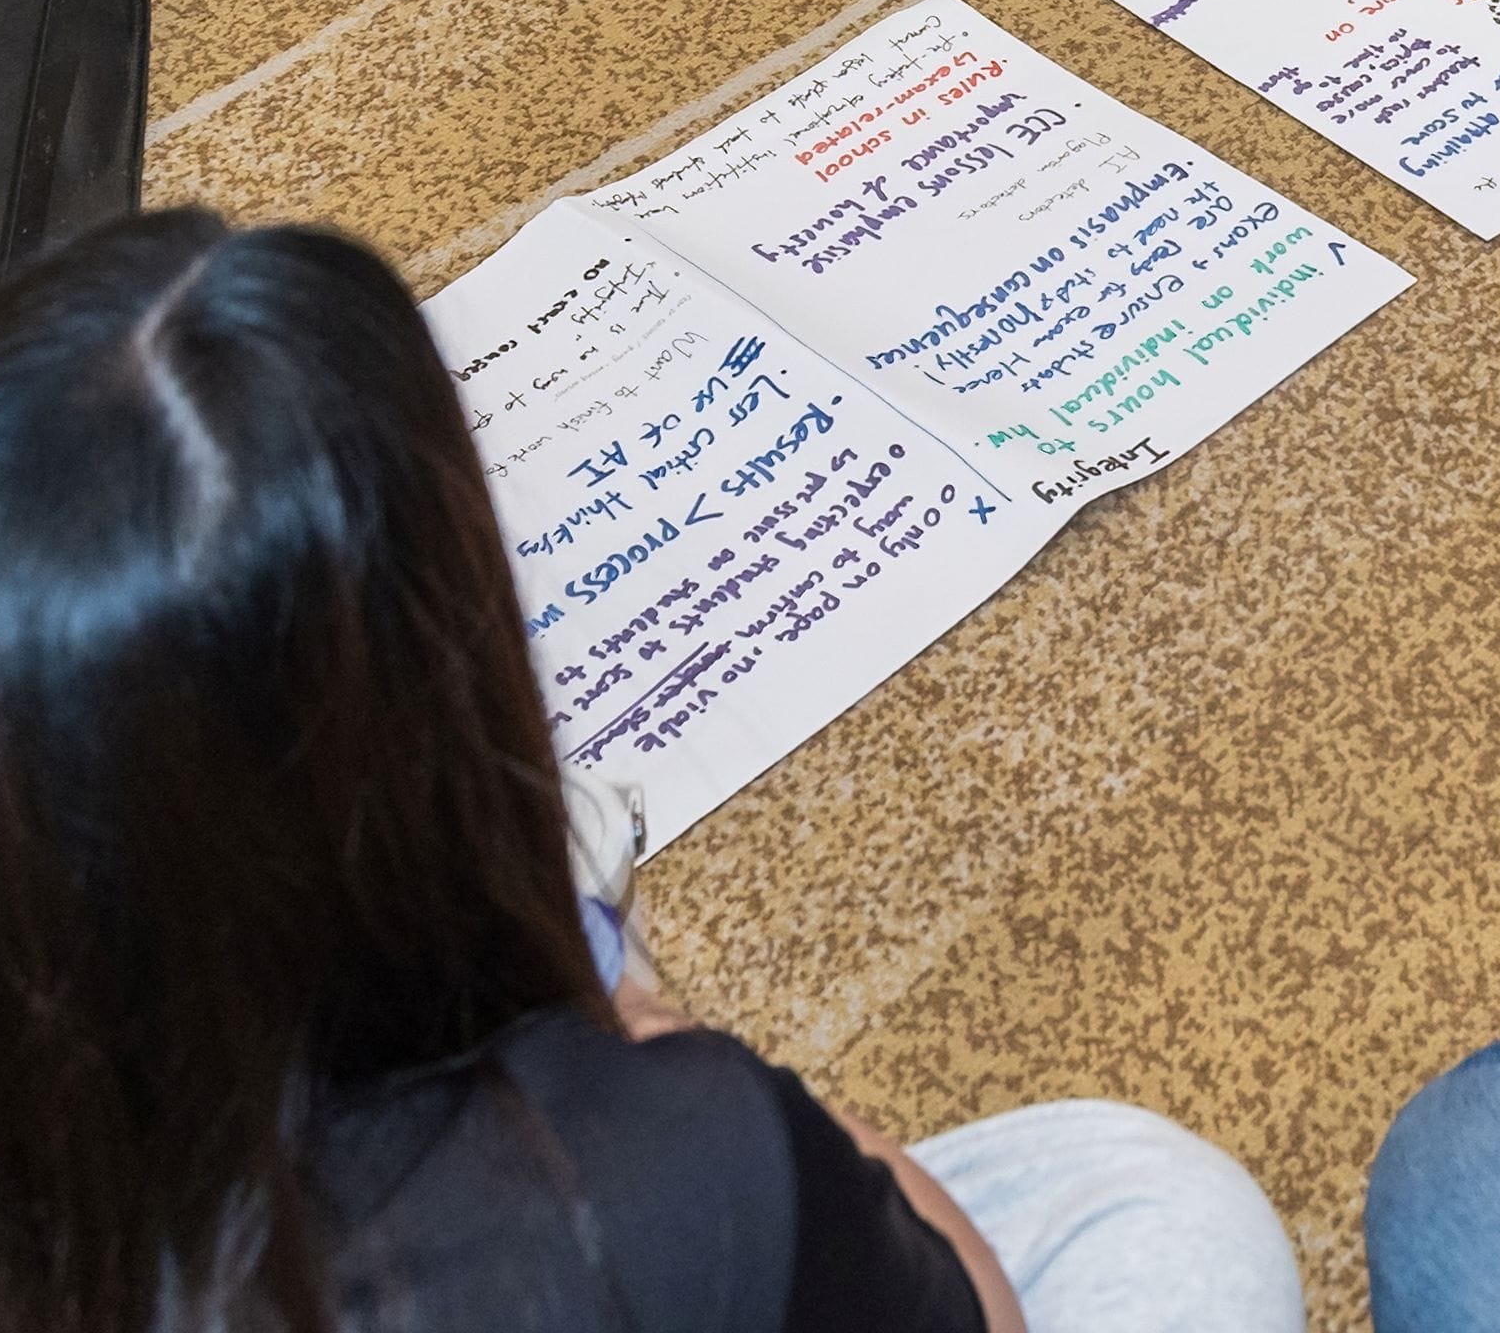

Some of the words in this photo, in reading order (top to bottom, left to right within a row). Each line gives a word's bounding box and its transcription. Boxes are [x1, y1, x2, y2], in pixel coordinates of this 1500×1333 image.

[1324, 21, 1355, 42] on
[793, 64, 951, 166] exam-related
[900, 106, 931, 126] in
[813, 128, 892, 183] school
[916, 142, 1015, 198] lessons
[749, 198, 866, 263] honesty
[793, 194, 918, 274] emphasise
[1068, 161, 1190, 250] Emphasis
[1248, 225, 1314, 275] work
[1181, 262, 1325, 366] individual
[1200, 284, 1234, 310] on
[1047, 318, 1194, 427] individual
[1086, 368, 1182, 433] hours
[565, 439, 629, 488] AI
[719, 401, 835, 497] Results
[1030, 415, 1171, 508] Integrity
[1035, 437, 1076, 456] to
[742, 470, 828, 543] pressure
[773, 460, 892, 552] expecting
[563, 516, 681, 605] process
[830, 546, 862, 570] to
[840, 560, 882, 589] on
[587, 576, 701, 660] students
[667, 552, 781, 636] students
[733, 569, 825, 638] confirm
[555, 664, 587, 686] to
[637, 638, 668, 661] to
[632, 688, 719, 753] viable
